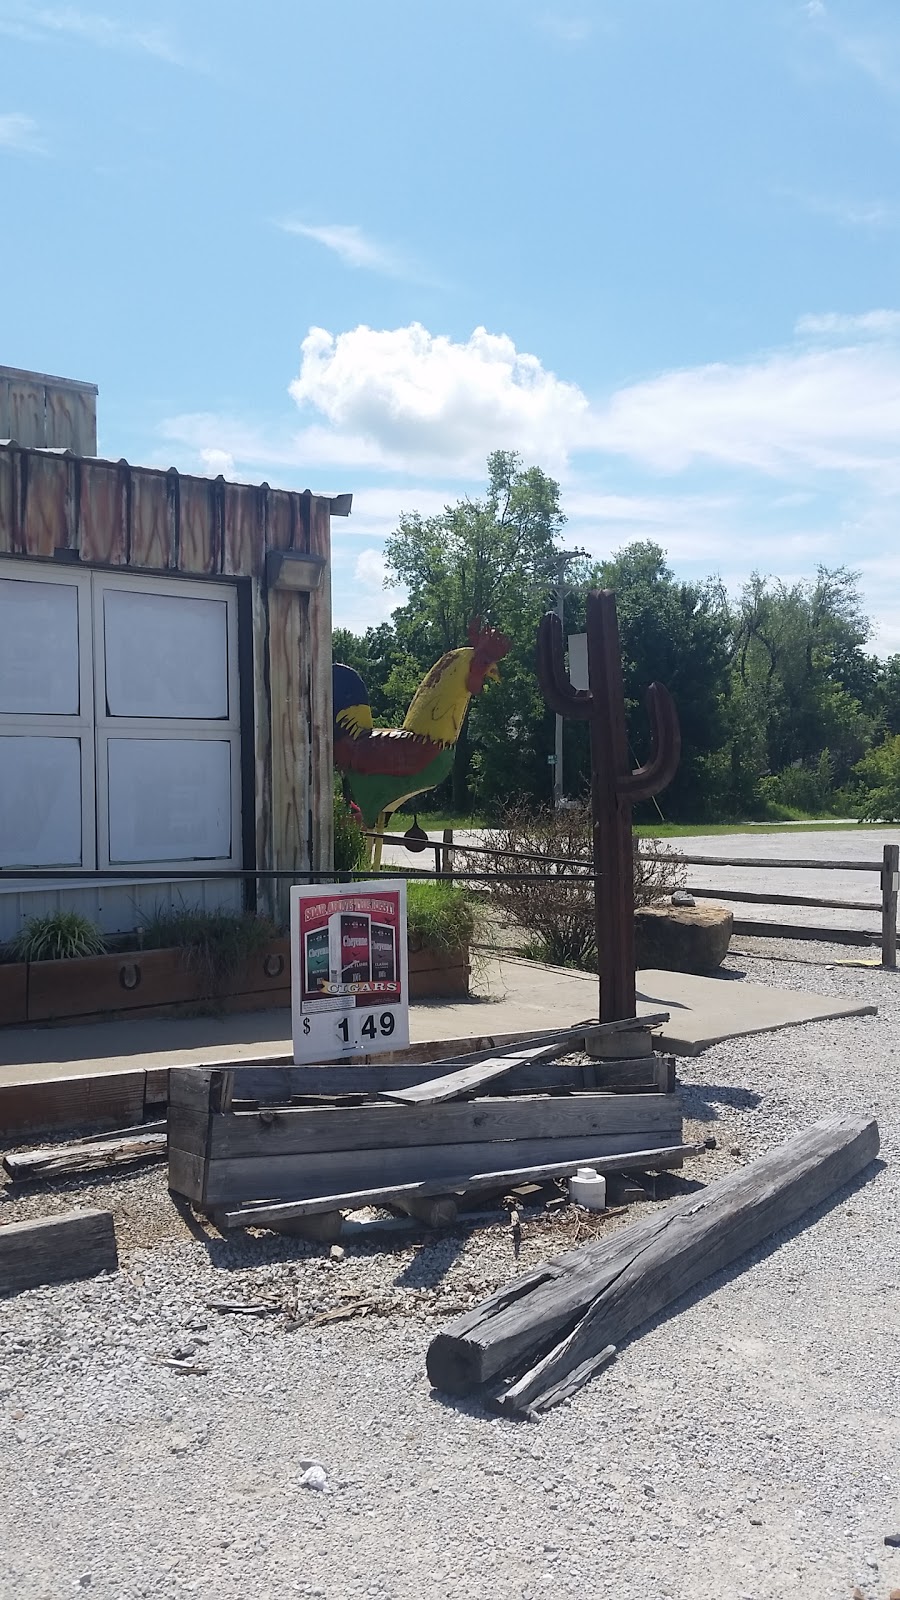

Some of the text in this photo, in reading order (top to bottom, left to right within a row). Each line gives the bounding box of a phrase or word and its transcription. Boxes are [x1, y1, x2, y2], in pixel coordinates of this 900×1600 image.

[304, 903, 327, 922] SOAR
[327, 899, 354, 914] ABOVE
[354, 899, 371, 911] THE
[342, 935, 368, 948] Cheyenne
[327, 982, 397, 993] CIGARS
[303, 1017, 311, 1035] $
